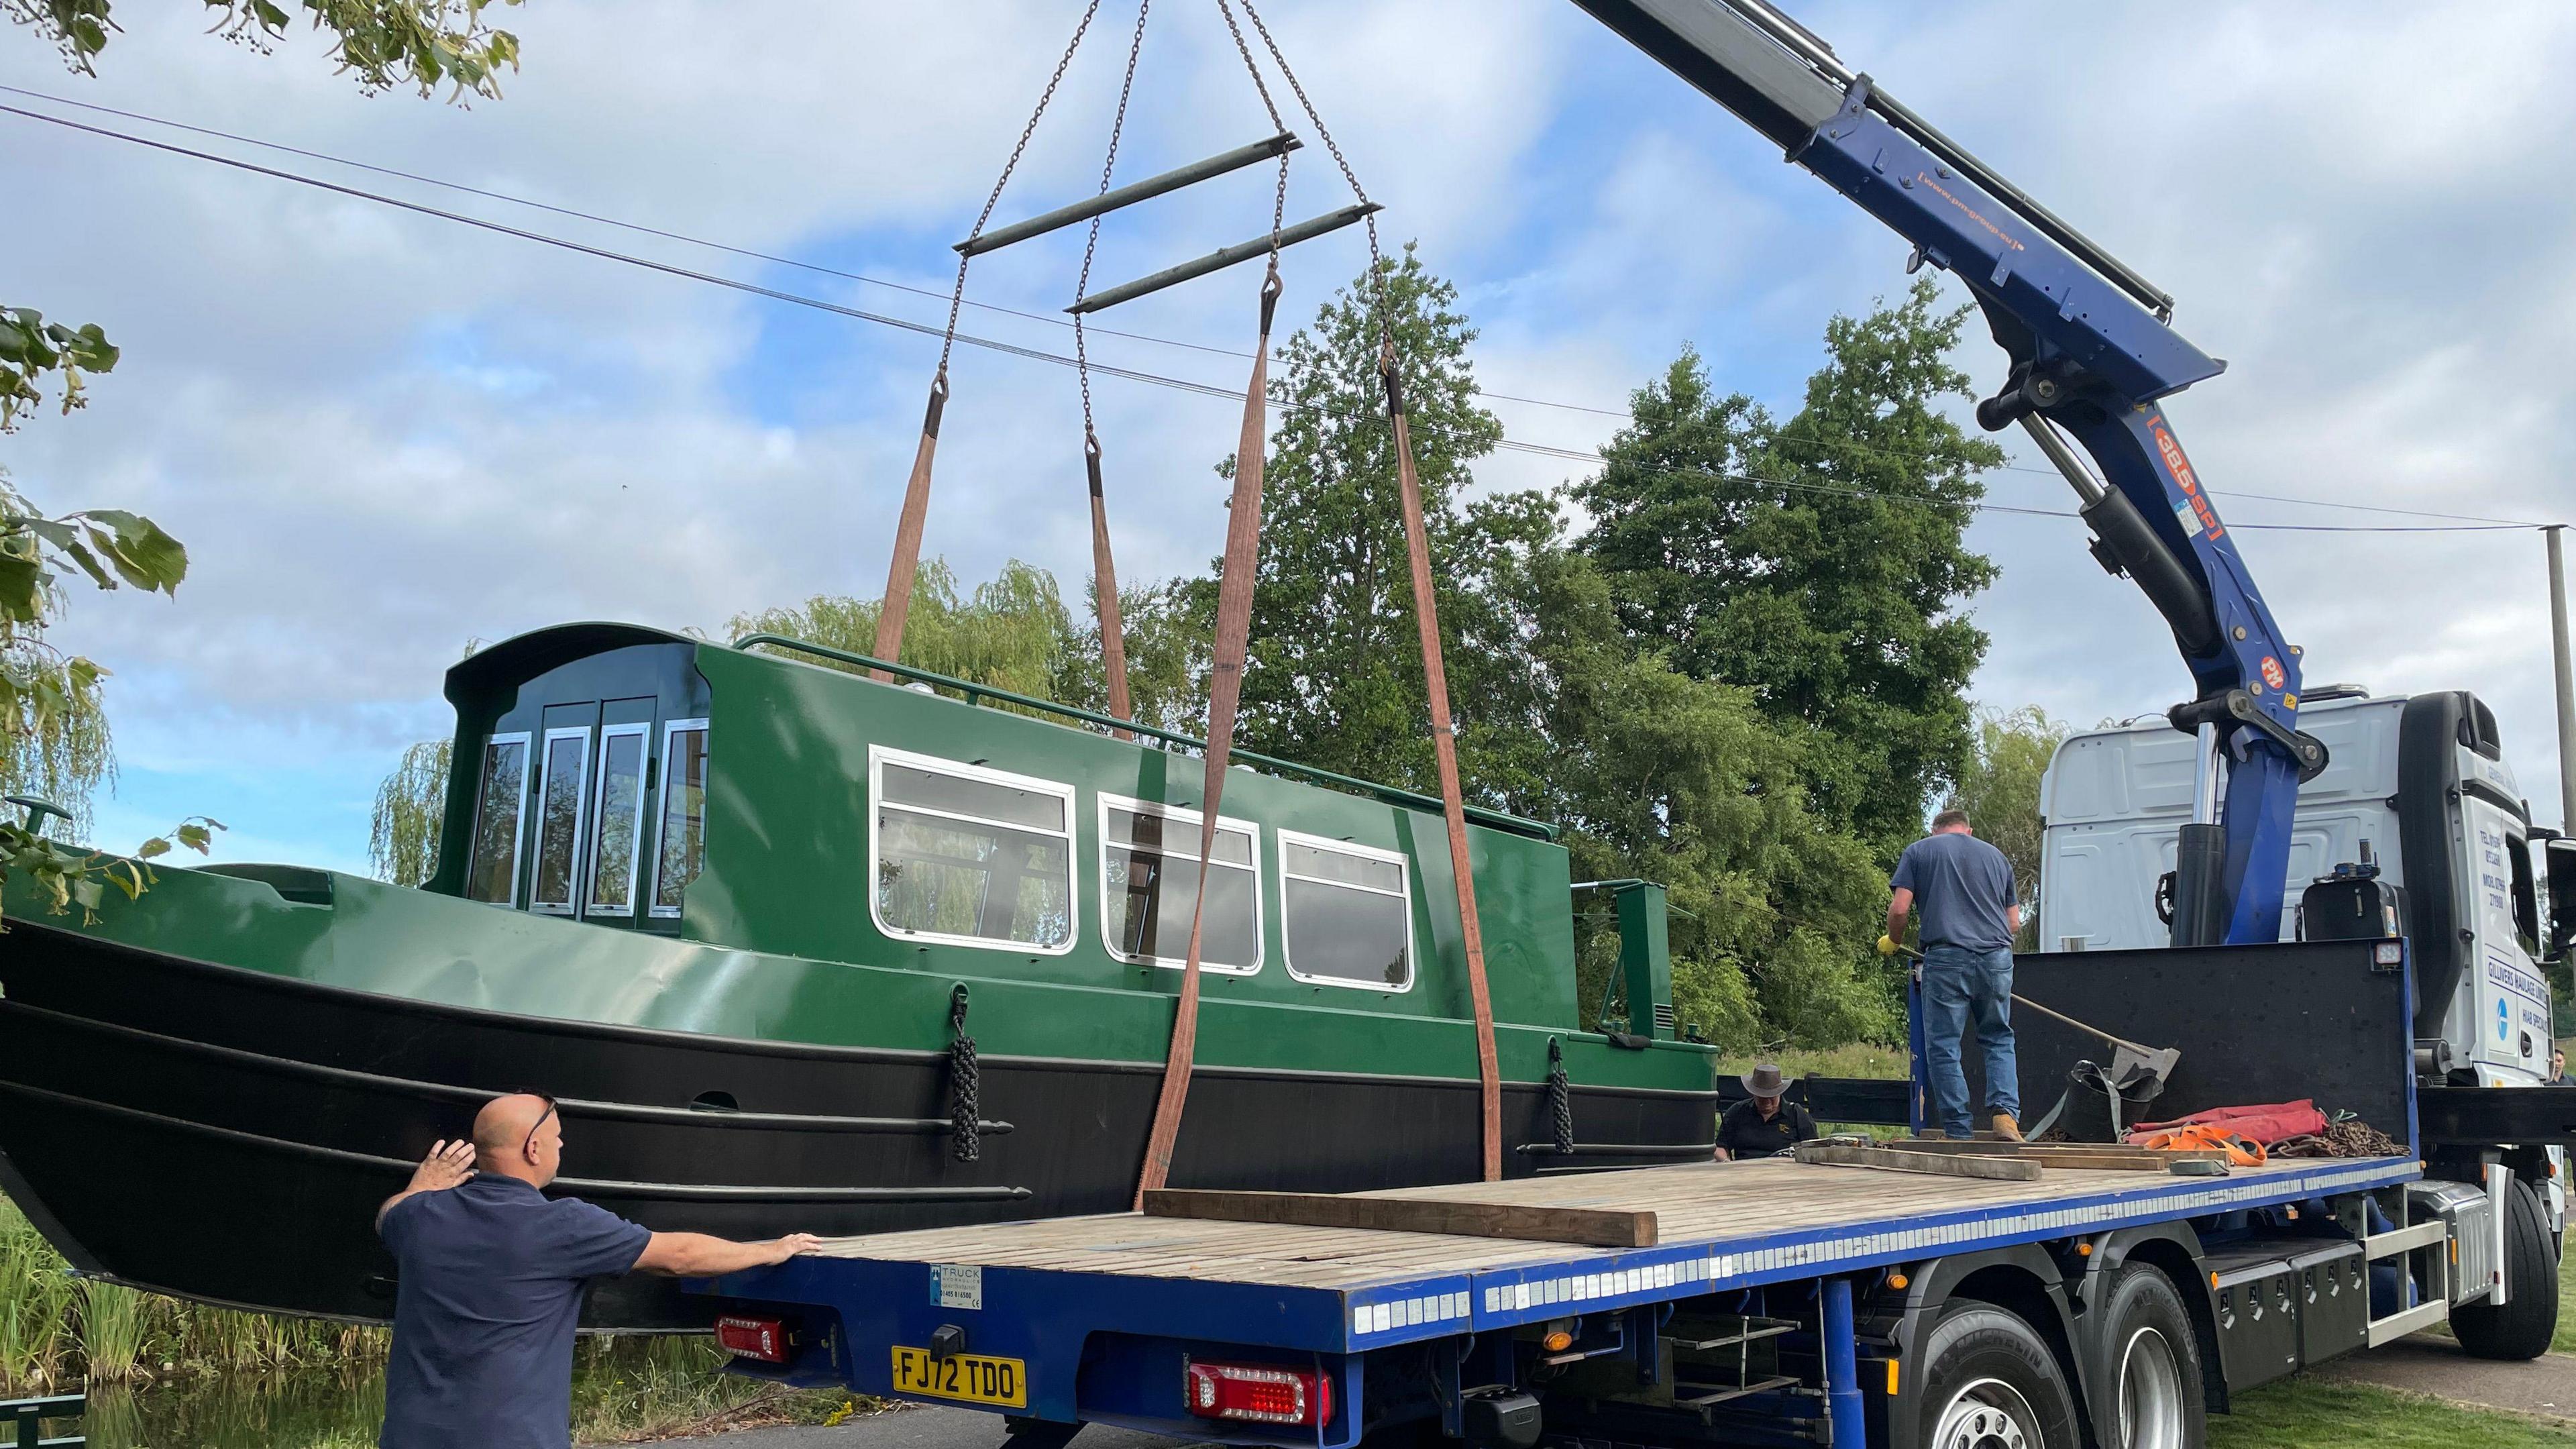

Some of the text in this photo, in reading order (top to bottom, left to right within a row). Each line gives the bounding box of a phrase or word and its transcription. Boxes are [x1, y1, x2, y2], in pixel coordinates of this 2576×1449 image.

[2261, 658, 2284, 688] PM
[2488, 961, 2514, 987] GILLIVERS
[2514, 973, 2535, 997] HAULAGE
[943, 1267, 979, 1279] TRUCK
[900, 1352, 1014, 1399] FJ72 TDO
